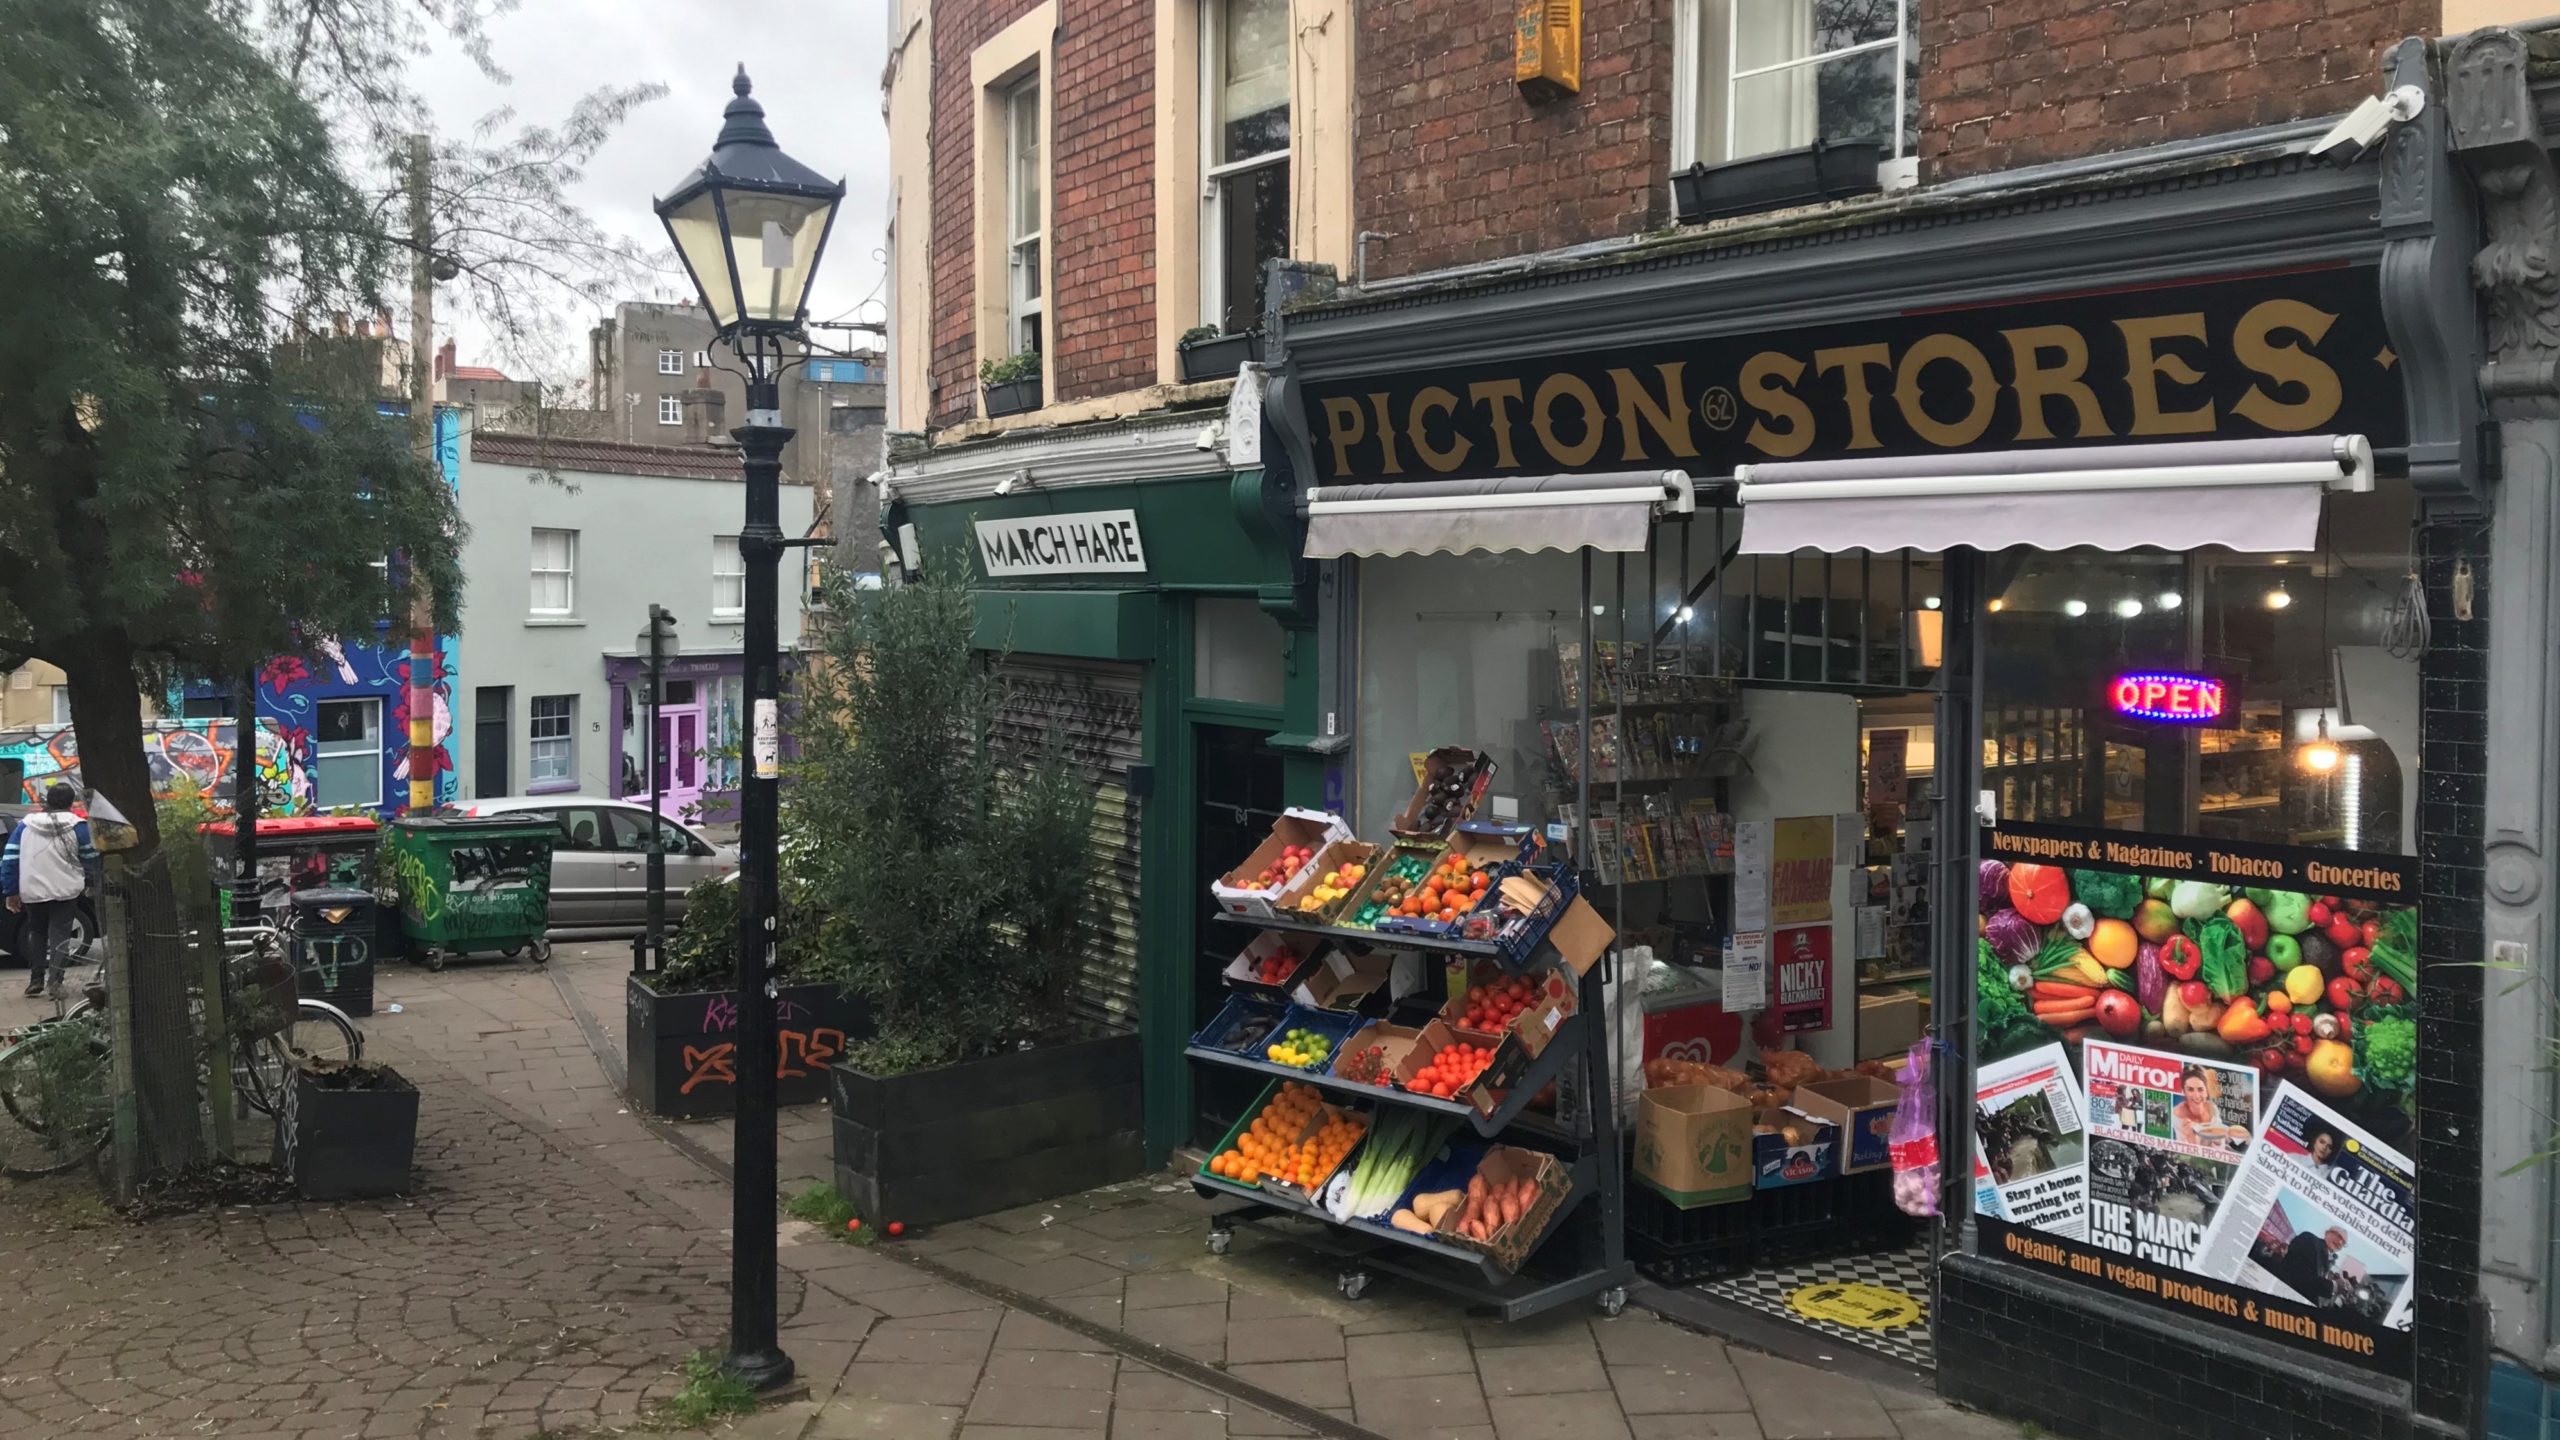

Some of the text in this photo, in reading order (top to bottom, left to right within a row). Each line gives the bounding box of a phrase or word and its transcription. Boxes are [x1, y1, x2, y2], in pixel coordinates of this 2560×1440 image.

[1320, 299, 2342, 477] PICTON 62 STORES
[982, 521, 1139, 567] MARCH HARE
[2117, 681, 2221, 715] OPEN
[1235, 809, 1248, 826] 64
[1992, 832, 2401, 891] Newspapers & Magazines Tobacco Groceries
[1748, 962, 1762, 972] NO!
[1780, 960, 1825, 992] NICKY
[2090, 1048, 2179, 1089] Mirror
[2119, 1052, 2144, 1064] DAILY
[2091, 1096, 2115, 1111] 80%
[2094, 1125, 2126, 1142] BLACK
[2128, 1131, 2156, 1147] LIVES
[2157, 1137, 2200, 1155] MATTER
[2005, 1186, 2037, 1203] Stay
[2039, 1182, 2048, 1195] at
[2049, 1174, 2083, 1192] home
[2261, 1143, 2300, 1178] Corbyn
[2300, 1170, 2330, 1197] urges
[2332, 1192, 2366, 1219] voters
[2367, 1215, 2381, 1228] to
[2290, 1177, 2301, 1190] to
[2303, 1186, 2322, 1203] the
[2358, 1165, 2396, 1202] The
[2011, 1197, 2062, 1216] warning
[2062, 1189, 2081, 1203] for
[2020, 1202, 2084, 1228] orthern ci
[2090, 1199, 2132, 1236] THE
[2006, 1232, 2375, 1356] Organic and vegan products & much more
